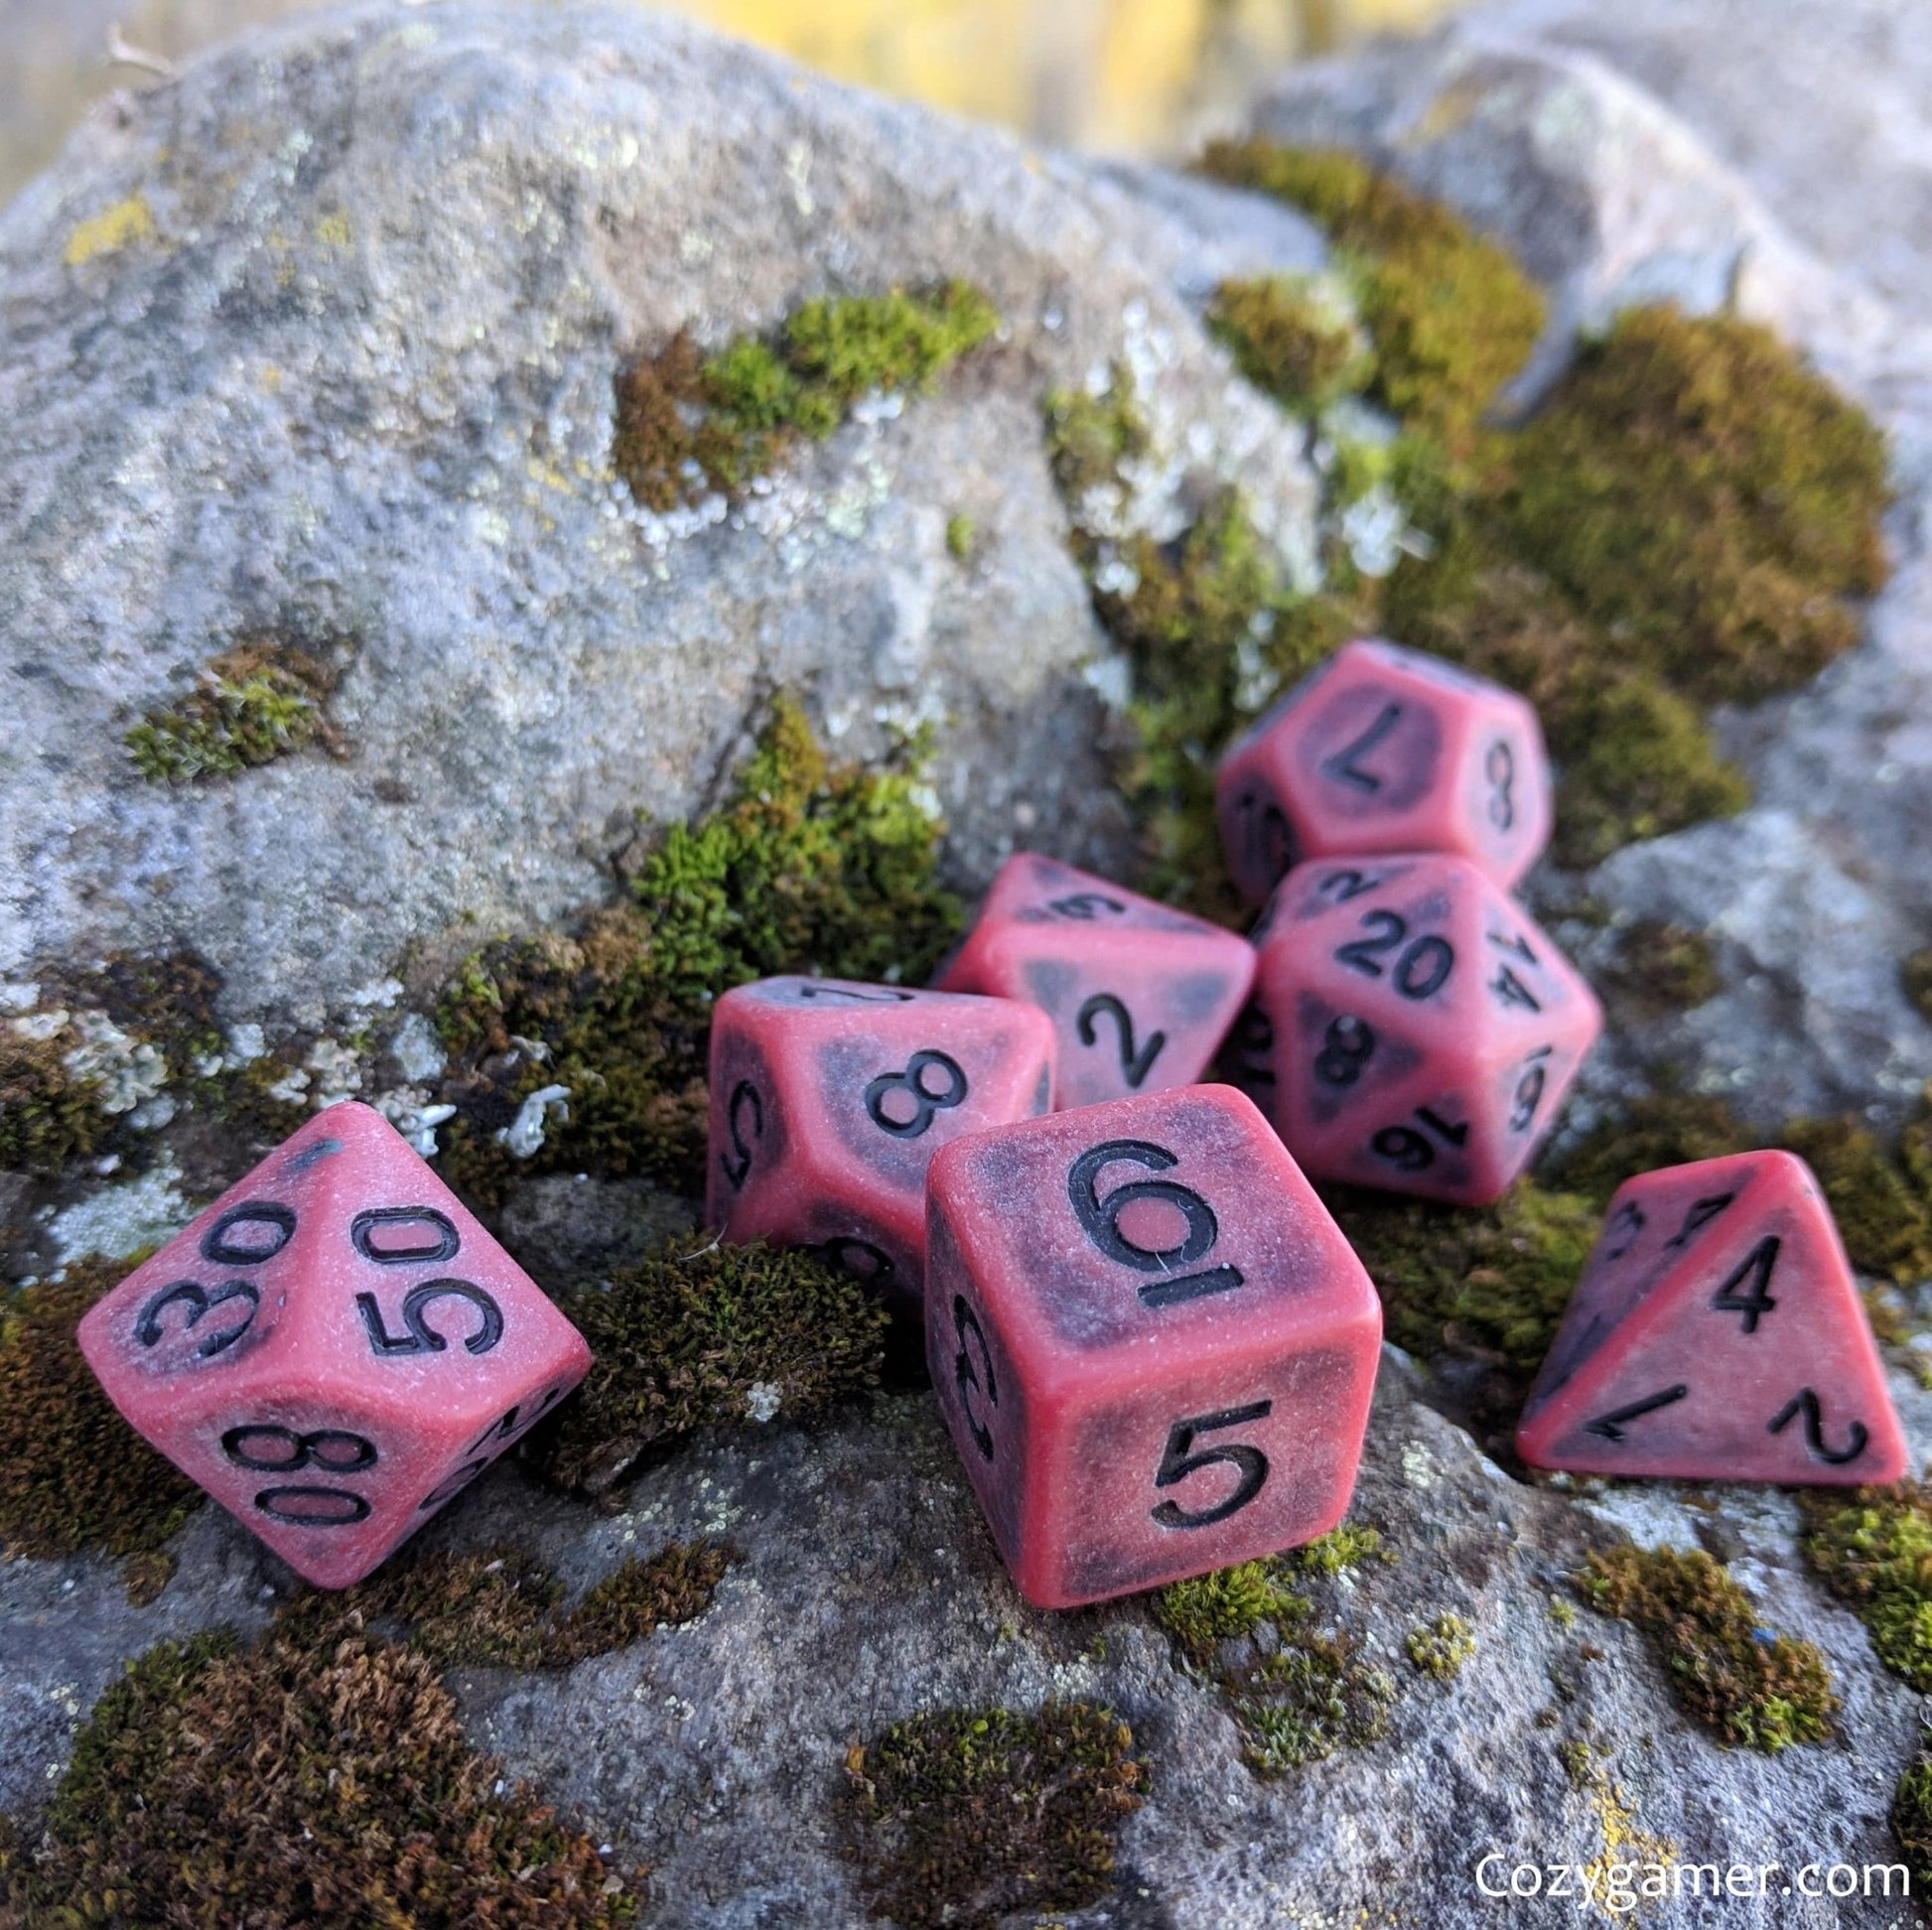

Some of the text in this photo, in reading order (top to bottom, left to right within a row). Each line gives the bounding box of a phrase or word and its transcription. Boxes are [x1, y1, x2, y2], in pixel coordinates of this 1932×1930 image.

[1323, 703, 1401, 791] 7
[1485, 741, 1513, 832] 8
[1318, 870, 1379, 902] 2
[1334, 909, 1454, 1000] 20
[1076, 993, 1165, 1088] 2
[1314, 1014, 1375, 1088] 8
[718, 1079, 762, 1190] 5
[865, 1049, 968, 1138] 8
[1067, 1139, 1244, 1308] 6
[133, 1200, 298, 1360] 30
[350, 1204, 504, 1356] 50
[1710, 1235, 1780, 1333] 4
[1583, 1384, 1688, 1440] 1
[1767, 1388, 1869, 1464] 2
[220, 1424, 379, 1527] 80
[1151, 1399, 1273, 1530] 5
